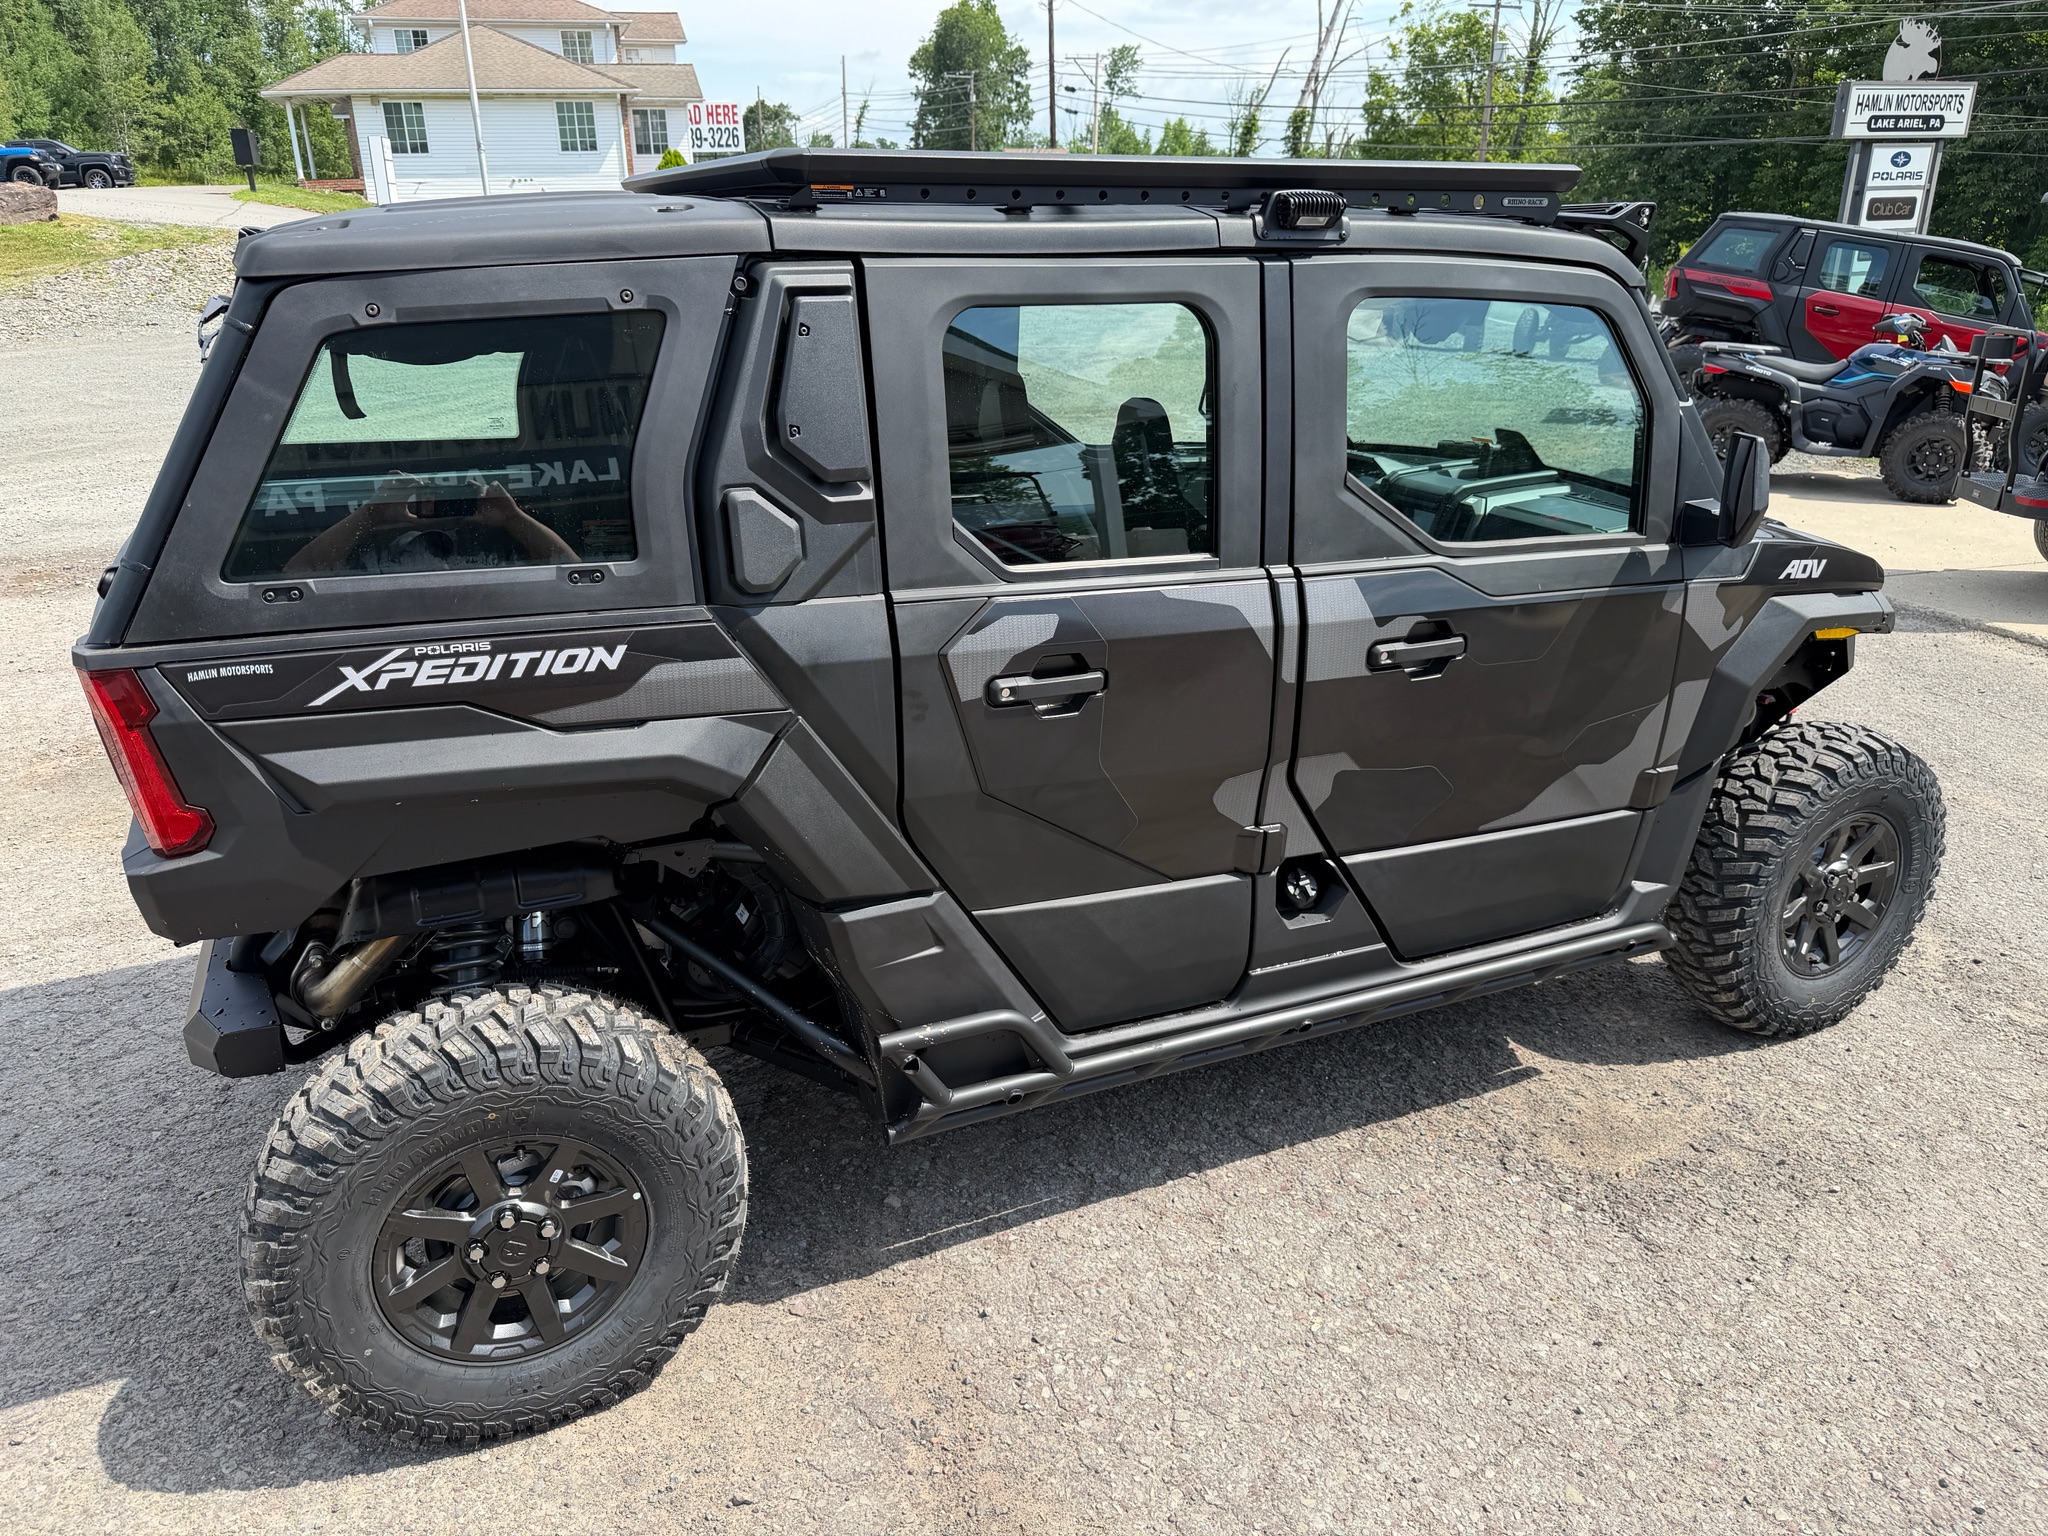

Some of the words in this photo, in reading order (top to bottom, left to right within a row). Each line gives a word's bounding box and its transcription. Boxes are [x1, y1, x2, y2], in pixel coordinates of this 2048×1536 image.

[1855, 93, 1894, 115] HAMLIN
[1895, 94, 1965, 114] MOTORSPORTS
[706, 104, 739, 125] HERE
[1871, 119, 1895, 128] LAKE
[1897, 119, 1927, 129] ARIEL,
[1929, 119, 1940, 128] PA
[1872, 171, 1924, 181] POLARIS
[1872, 202, 1893, 216] Club
[1894, 202, 1911, 215] Car
[1778, 559, 1827, 579] ADV
[414, 642, 491, 656] POLARIS
[187, 668, 218, 682] HAMLIN
[219, 664, 274, 678] MOTORSPORTS
[305, 645, 628, 707] XPEDITION
[407, 1112, 504, 1166] ARMOR
